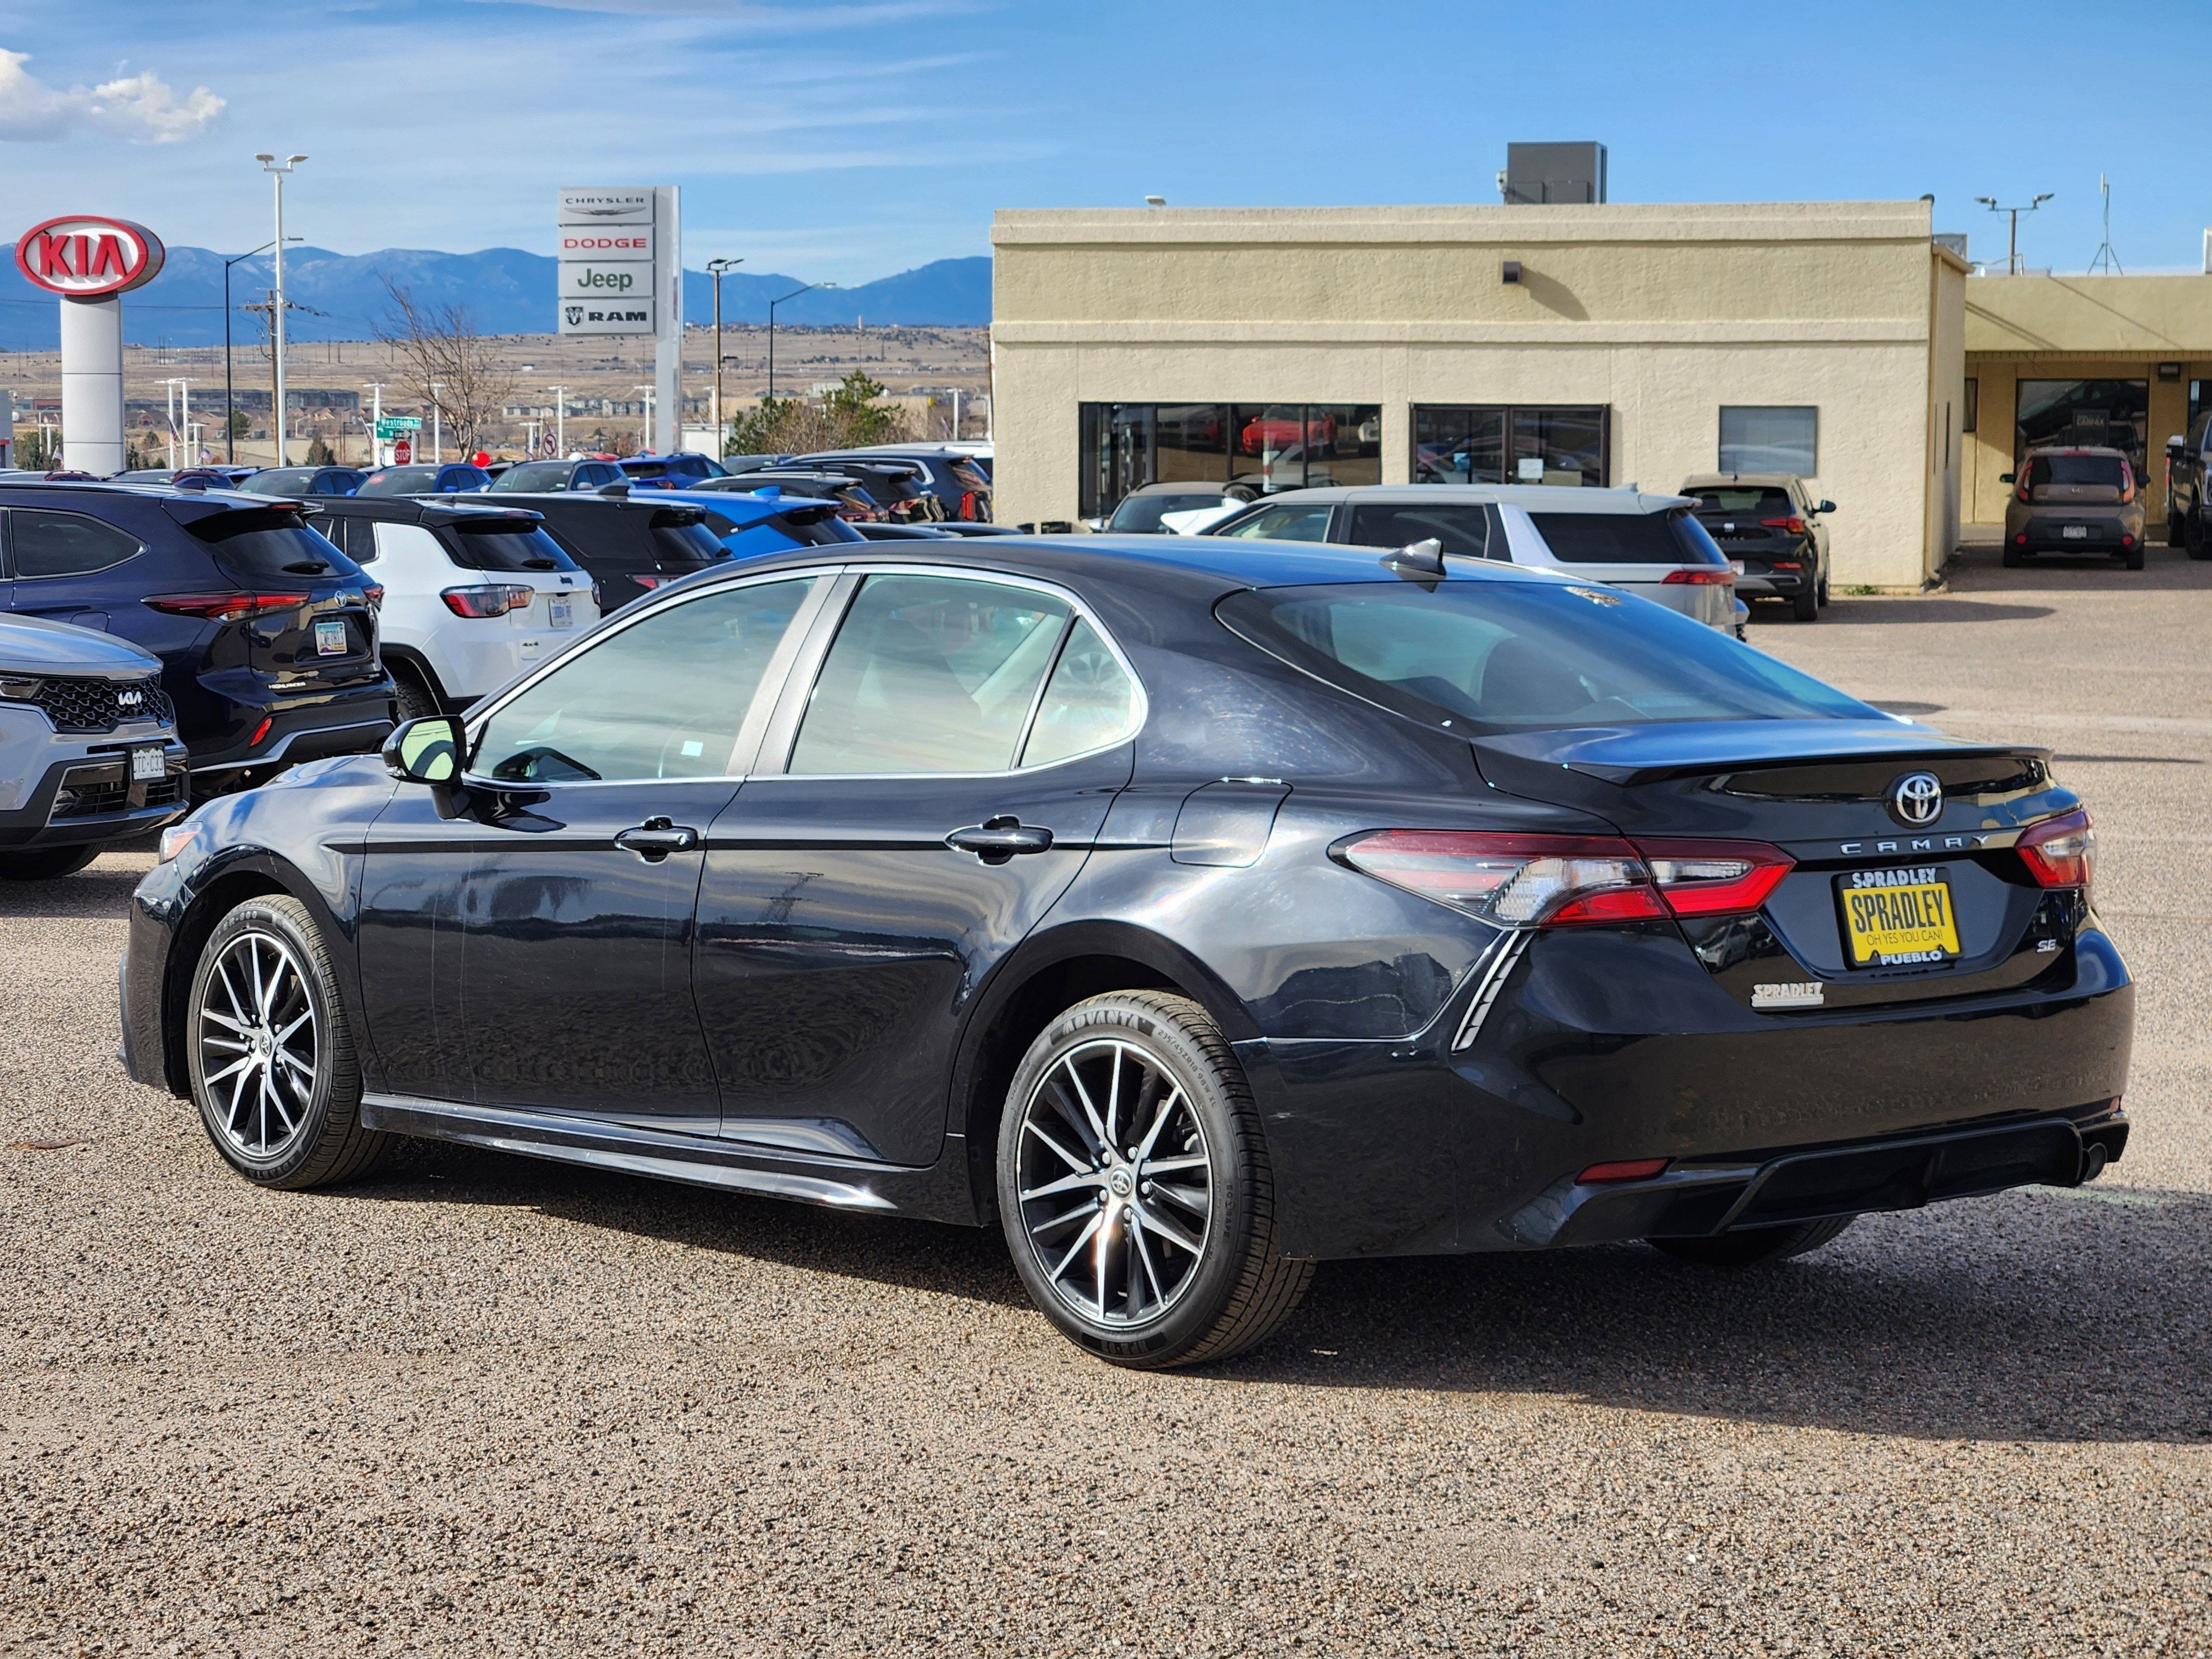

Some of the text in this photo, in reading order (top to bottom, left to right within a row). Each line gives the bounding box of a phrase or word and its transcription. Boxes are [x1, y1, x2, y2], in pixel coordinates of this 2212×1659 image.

[564, 238, 646, 248] DODGE
[38, 234, 128, 276] KIA
[577, 268, 633, 292] Jeep
[588, 311, 647, 321] RAM
[395, 449, 411, 461] STOP
[118, 691, 142, 705] KIA
[1840, 834, 1990, 855] CAMRY
[1852, 867, 1936, 889] SPRADLEY
[1850, 889, 1945, 933] SPRADLEY
[1866, 929, 1944, 946] OH YES YOU CAN!
[2037, 939, 2057, 953] SE
[1880, 950, 1943, 966] PUEBLO
[1752, 982, 1824, 999] SPRADLEY
[1062, 1010, 1139, 1036] ADVANTA
